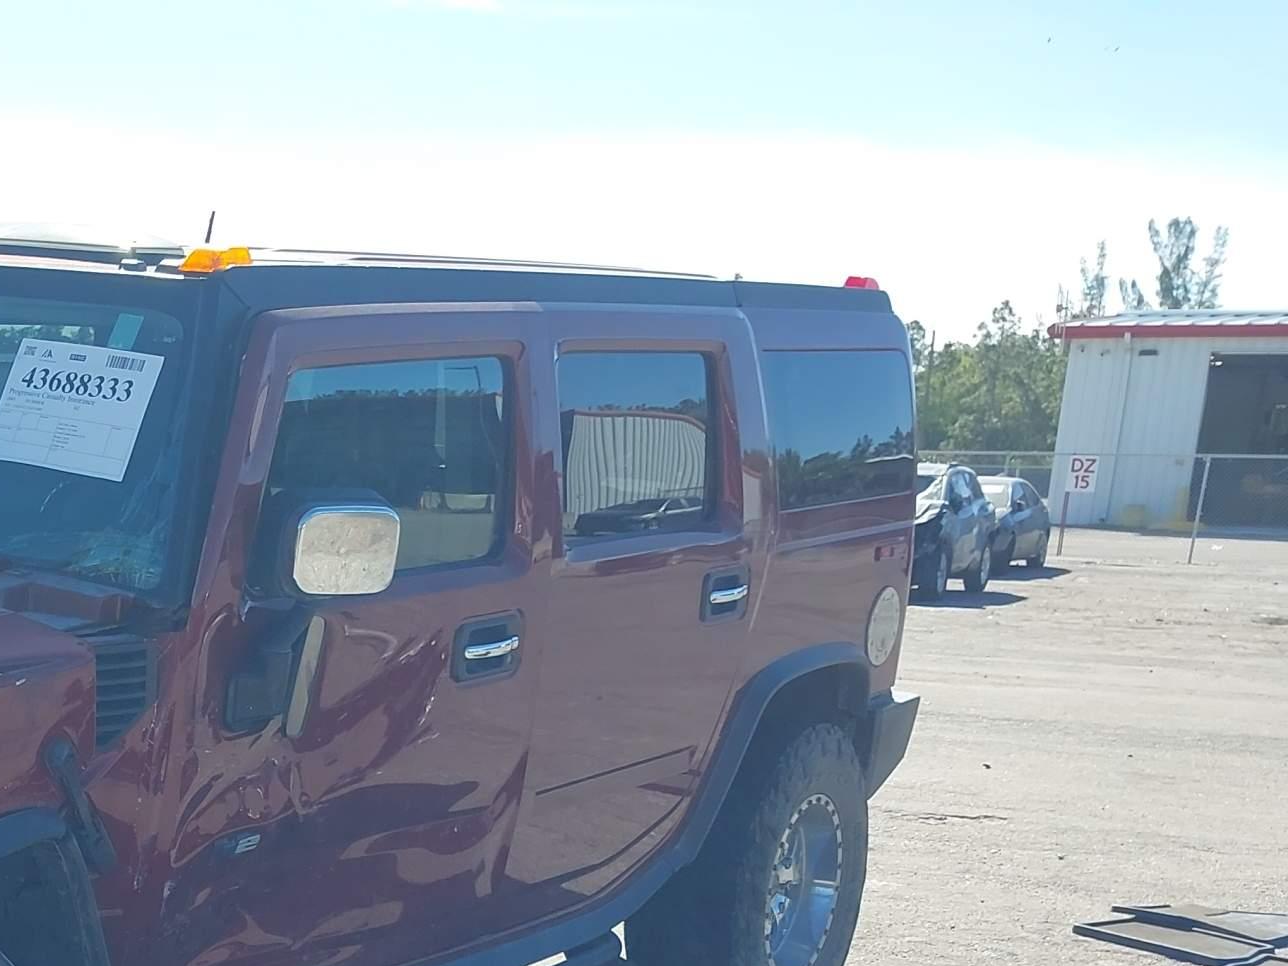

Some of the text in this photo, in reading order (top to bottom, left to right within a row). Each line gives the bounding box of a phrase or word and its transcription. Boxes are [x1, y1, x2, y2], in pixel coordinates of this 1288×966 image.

[21, 367, 133, 402] 43688333
[1071, 458, 1097, 473] DZ
[1074, 475, 1090, 489] 15
